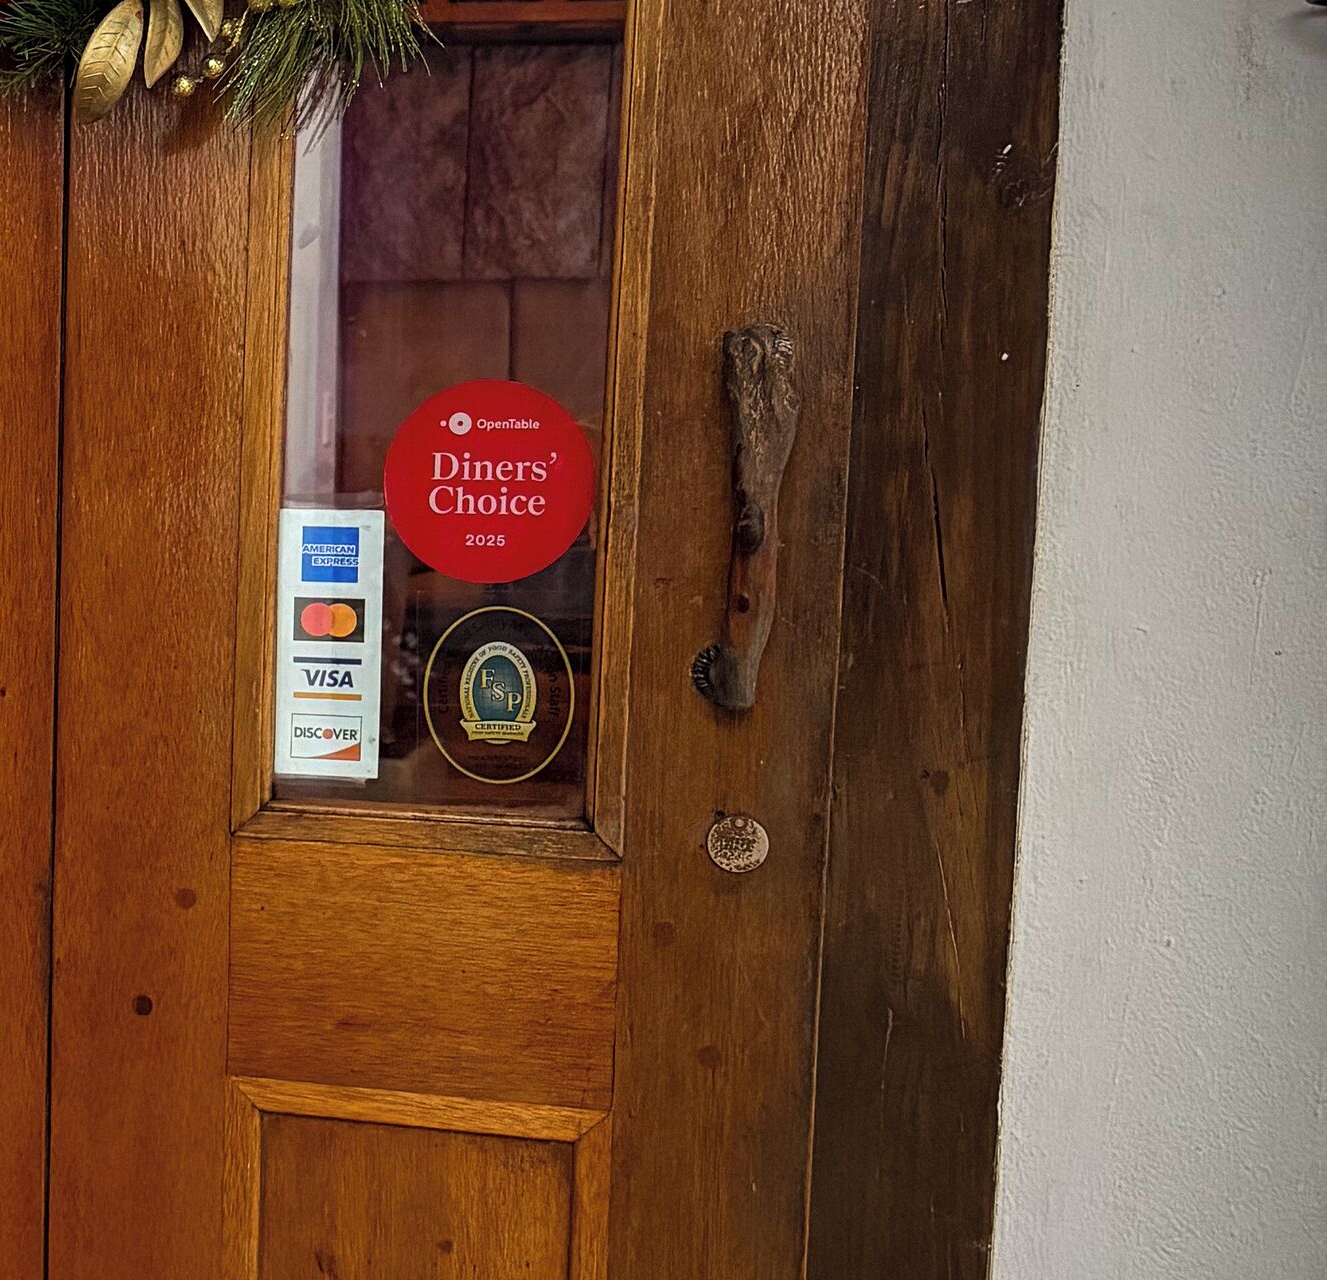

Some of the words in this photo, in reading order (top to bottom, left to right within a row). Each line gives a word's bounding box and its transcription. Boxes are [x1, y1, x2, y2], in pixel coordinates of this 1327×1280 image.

[476, 418, 540, 432] OpenTable
[430, 451, 557, 482] Diners’
[428, 485, 546, 516] Choice
[464, 534, 506, 547] 2025
[302, 544, 355, 555] AMERICAN
[313, 557, 359, 566] EXPRESS
[301, 669, 354, 688] VISA
[548, 686, 562, 718] Staff
[294, 726, 358, 741] DISCOVER
[475, 723, 522, 731] CERTIFIED
